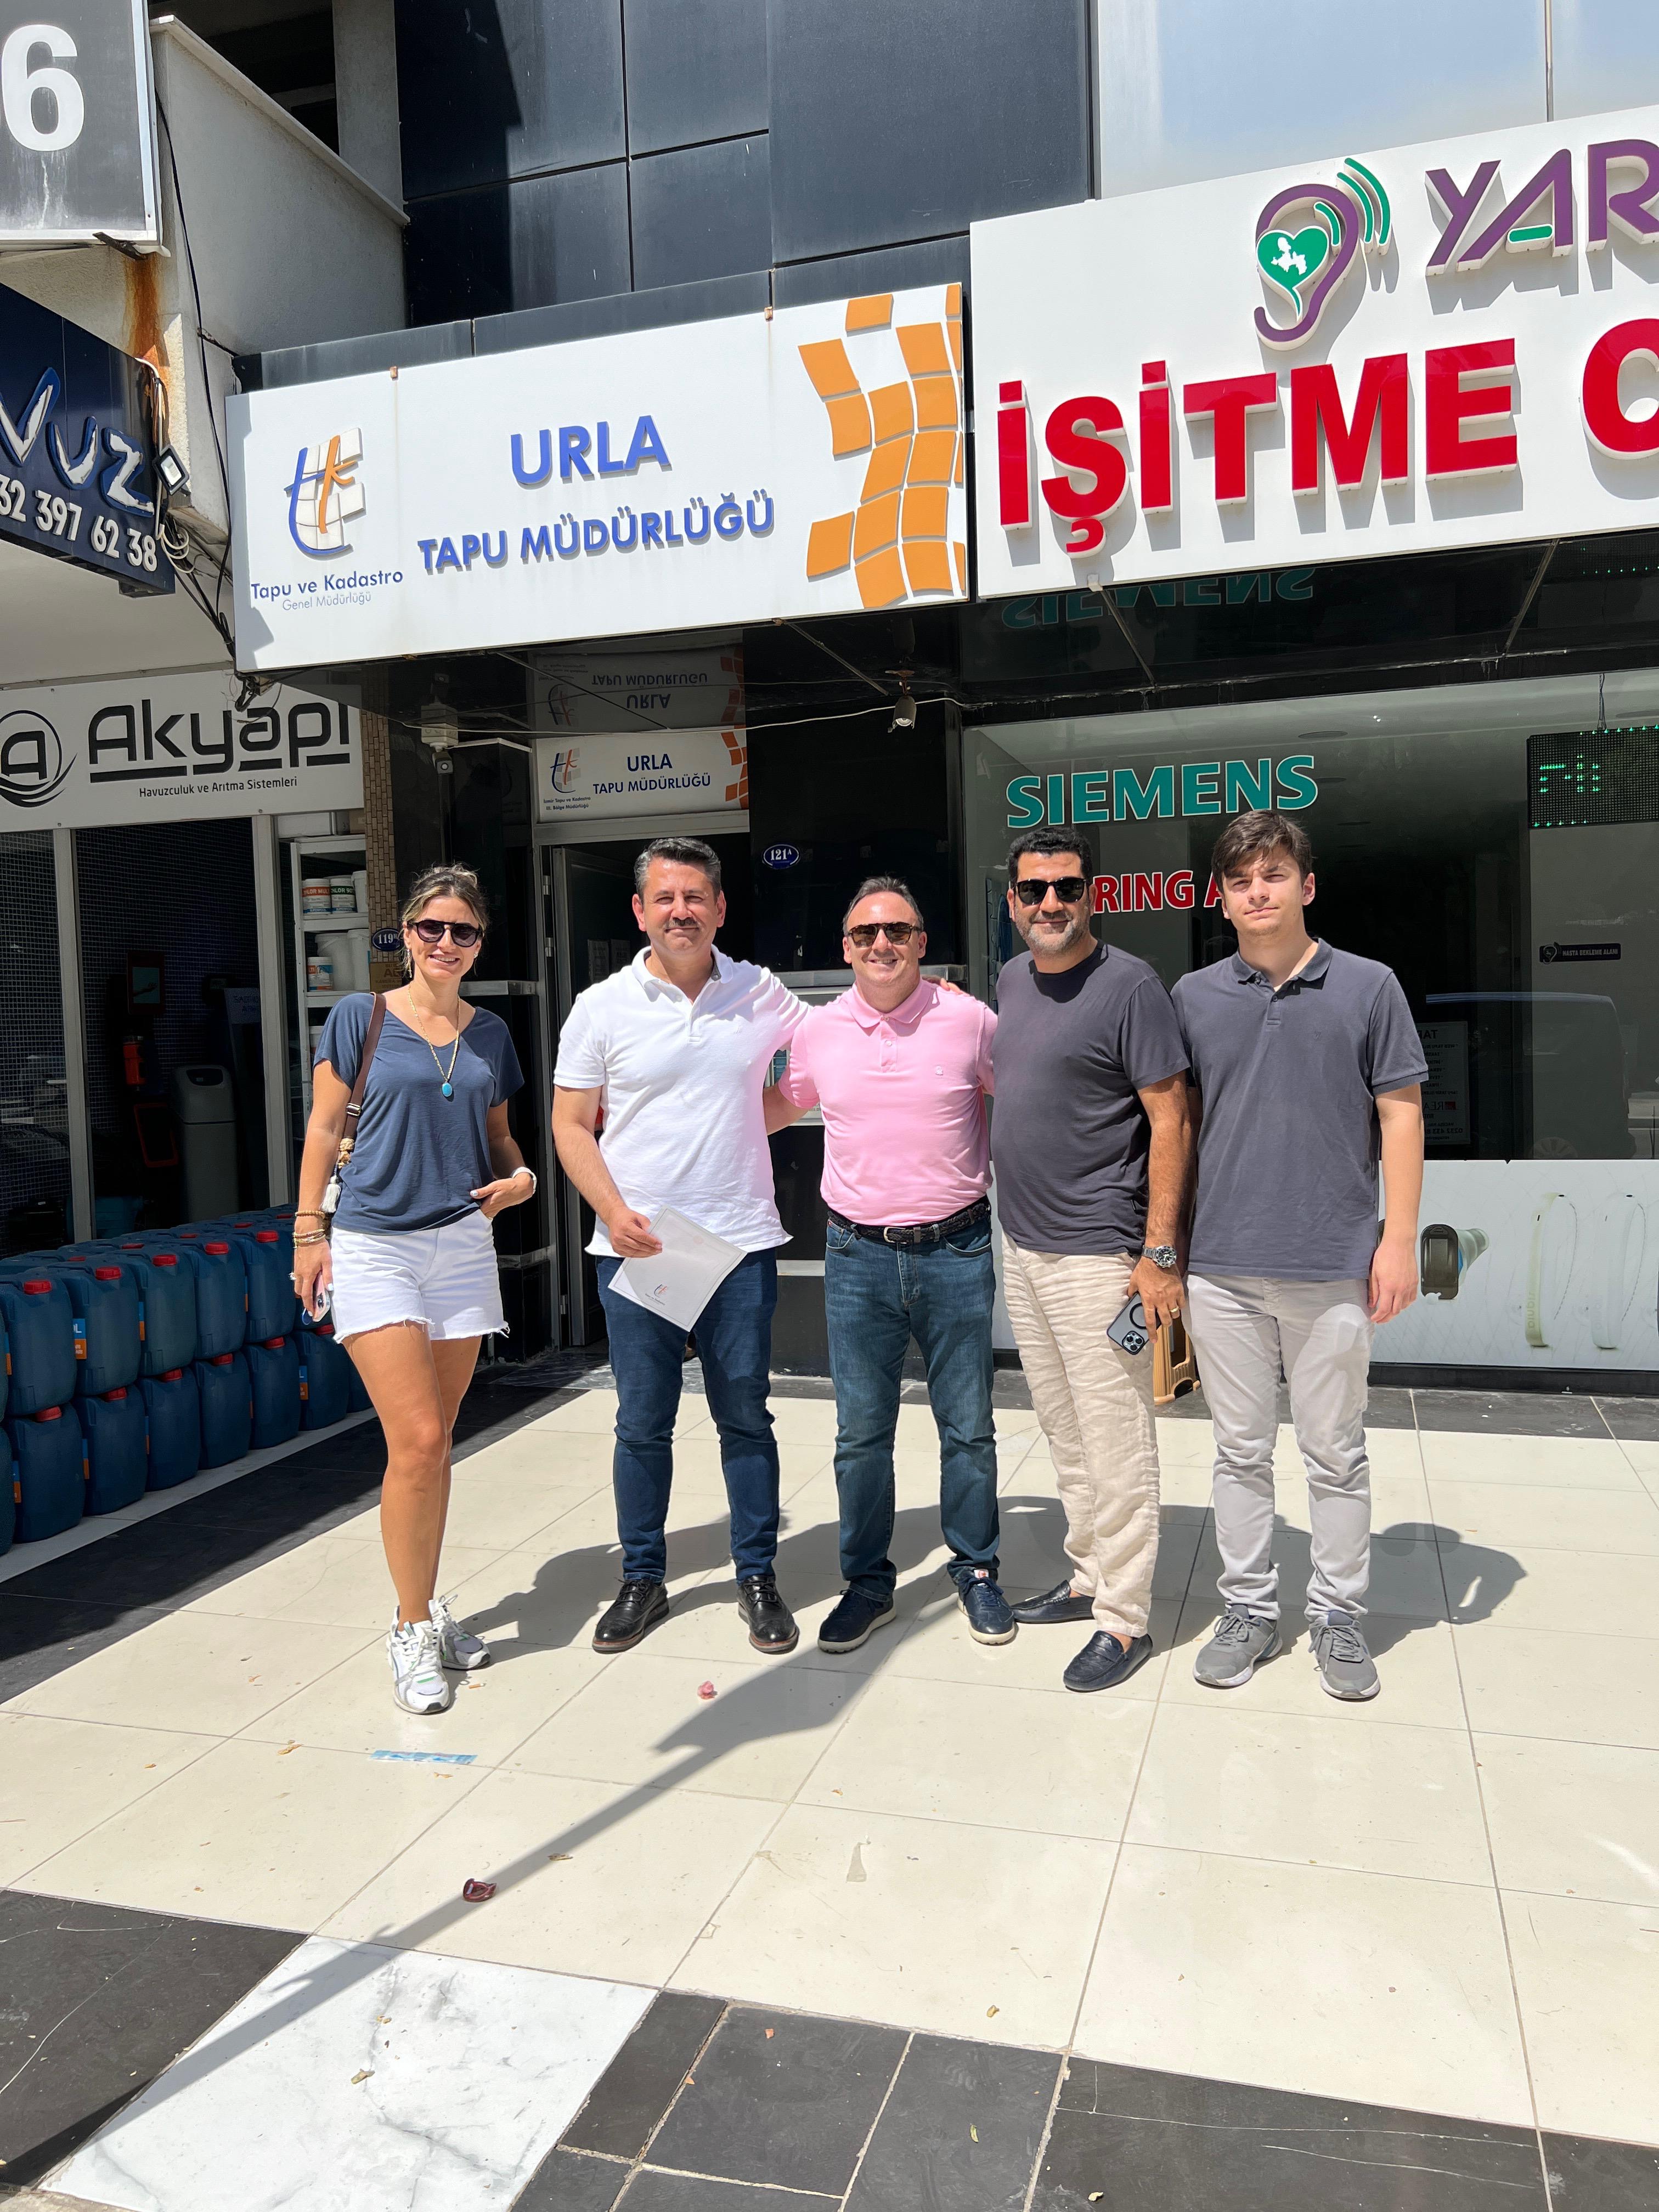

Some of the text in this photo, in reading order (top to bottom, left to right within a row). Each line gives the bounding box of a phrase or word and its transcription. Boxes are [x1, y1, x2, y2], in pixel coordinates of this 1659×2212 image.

[1, 25, 84, 151] 6
[510, 415, 670, 486] URLA
[997, 338, 1517, 556] İŞİTME
[35, 489, 82, 541] 397
[91, 515, 120, 558] 62
[127, 528, 157, 572] 38
[417, 489, 774, 571] TAPU MÜDÜRLÜĞÜ
[251, 571, 403, 601] Tapu ve Kadastro
[283, 591, 372, 611] Genel Müdürlüğü
[139, 776, 297, 797] Havuzculuk ve Arıtma Sistemleri
[593, 772, 711, 794] TAPU MÜDÜRLÜĞÜ
[627, 753, 673, 772] URLA
[1006, 755, 1318, 828] SIEMENS
